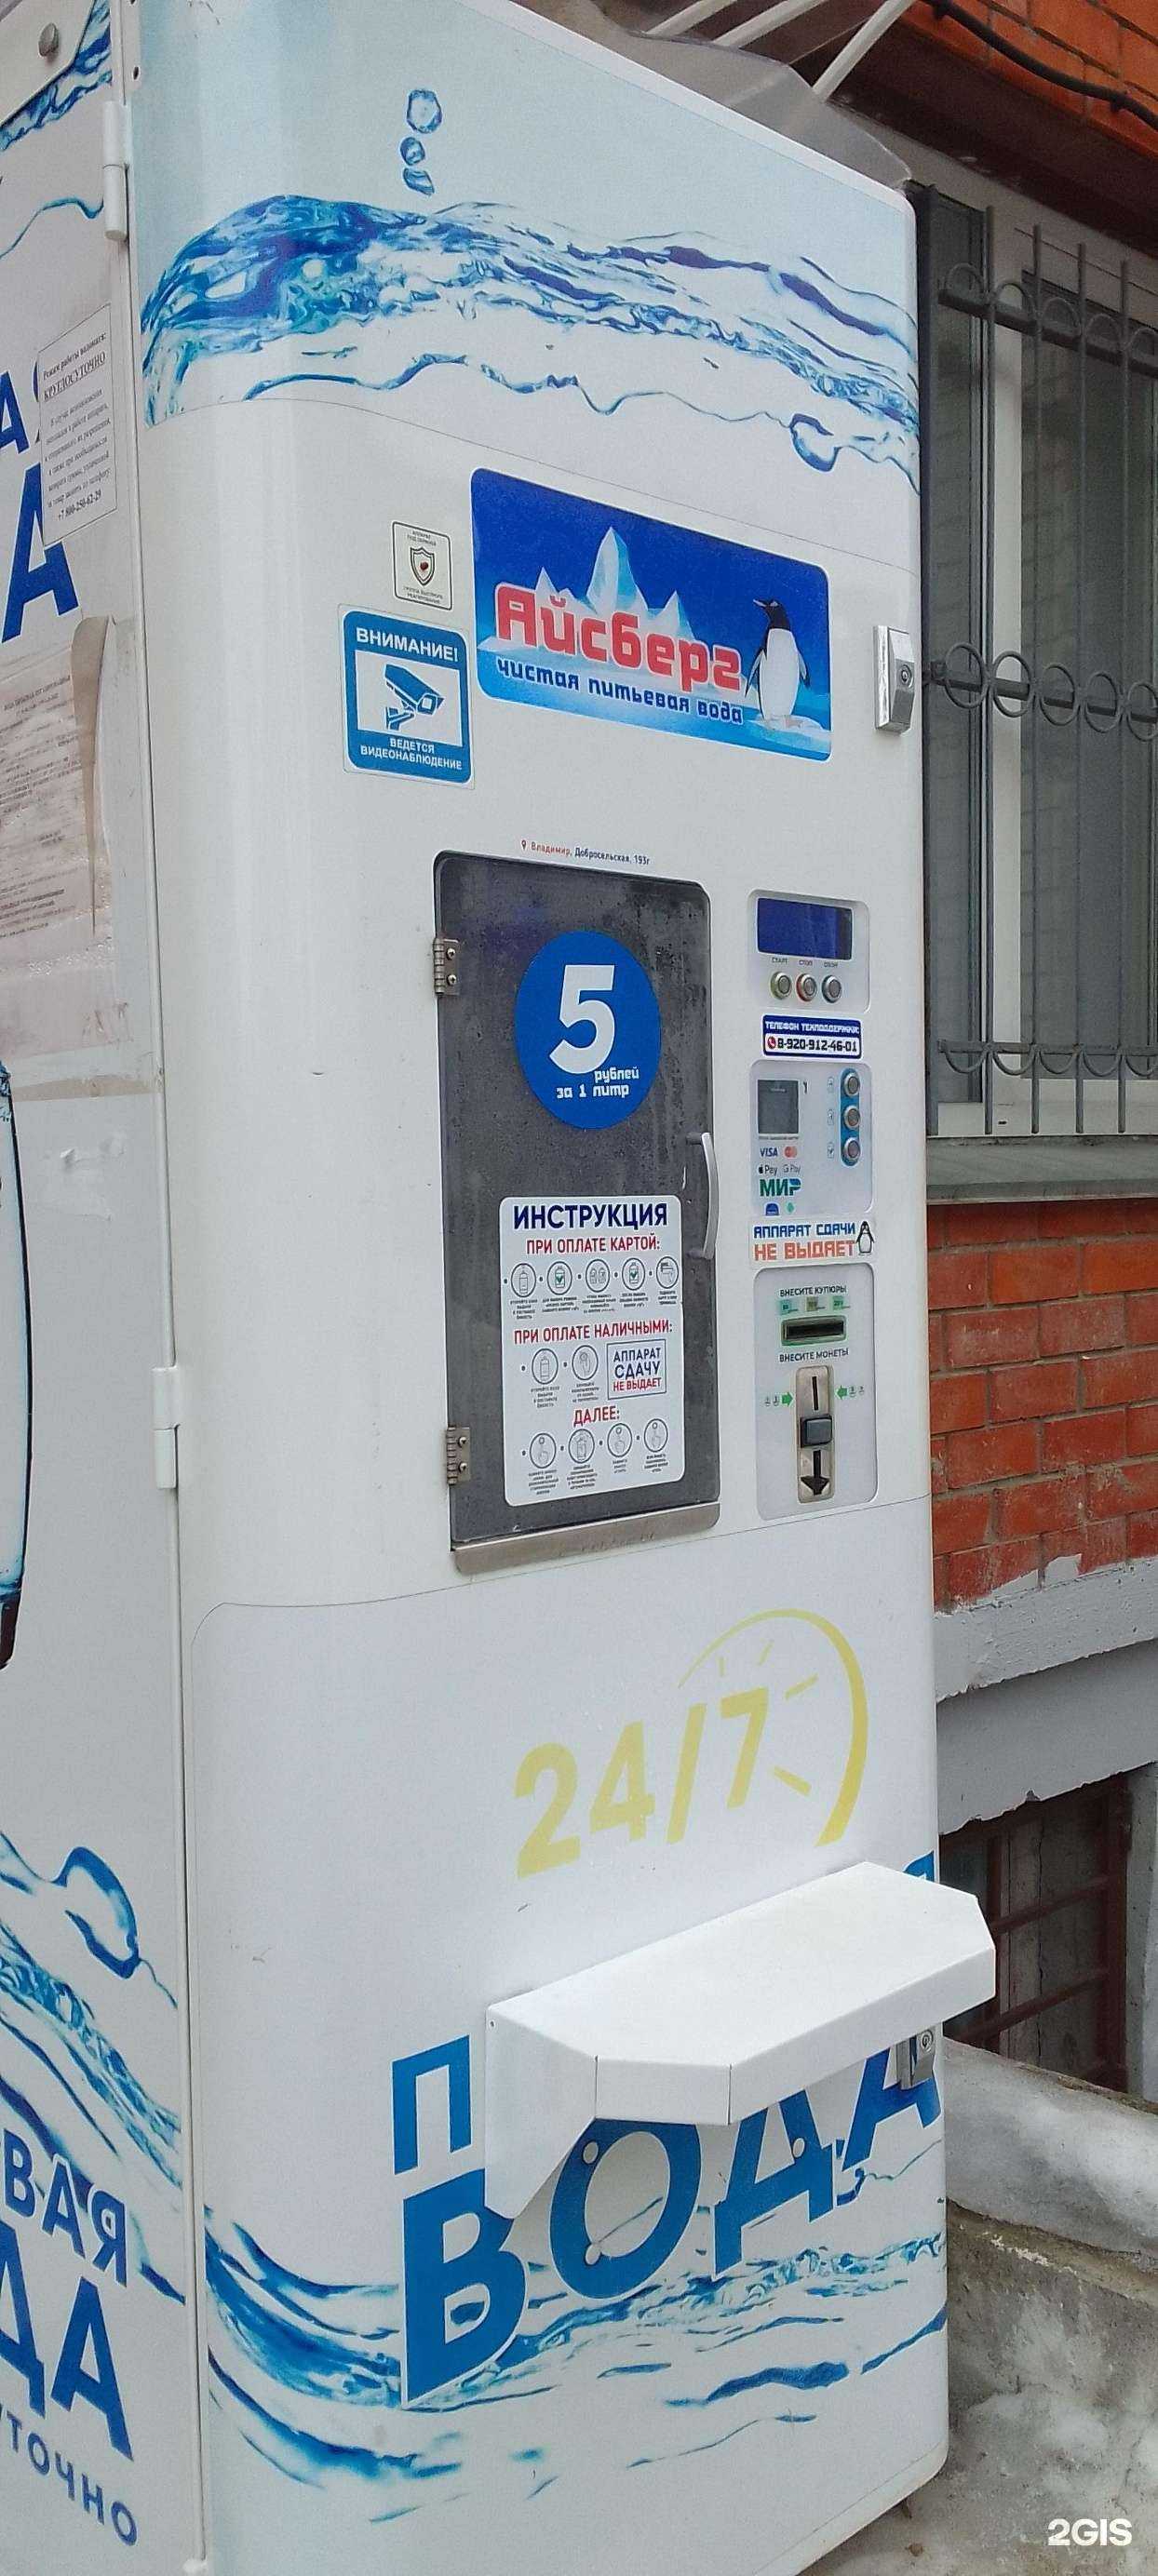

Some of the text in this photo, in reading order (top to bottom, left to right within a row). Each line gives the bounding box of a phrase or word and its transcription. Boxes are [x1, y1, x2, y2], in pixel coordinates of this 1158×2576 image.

[44, 349, 105, 403] КРУГЛОСУТОЧНО
[357, 627, 458, 662] ВНИМАНИЕ!
[495, 584, 742, 692] Айсберг
[497, 658, 743, 724] чистая питьевая вода
[390, 738, 435, 754] ВЕДЕТСЯ
[360, 745, 463, 771] ВИДЕОНАБЛЮДЕНИЕ
[532, 841, 651, 865] Владимир, Добросельская, 193г
[549, 964, 615, 1074] 5
[765, 1020, 800, 1031] ТЕЛЕФОН
[777, 1037, 857, 1053] 8-920-912-46-01
[594, 1067, 640, 1083] рублей
[557, 1083, 629, 1099] за 1 литр
[760, 1147, 778, 1157] VISA
[764, 1164, 778, 1176] Pay
[760, 1178, 801, 1197] МИР
[513, 1202, 667, 1230] ИНСТРУКЦИЯ
[754, 1222, 855, 1239] АППАРАТ СДАЧИ
[527, 1233, 660, 1254] ПРИ ОПЛАТЕ КАРТОЙ:
[754, 1240, 855, 1261] НЕ ВЫДАЕТ
[780, 1284, 847, 1297] ВНЕСИТЕ КУПЮРЫ
[514, 1320, 672, 1345] ПРИ ОПЛАТЕ НАЛИЧНЫМИ:
[613, 1348, 661, 1363] АППАРАТ
[779, 1348, 849, 1362] ВНЕСИТЕ МОНЕТЫ
[614, 1361, 661, 1380] СДАЧУ
[613, 1381, 625, 1392] НЕ
[626, 1377, 662, 1390] ВЫДАЕТ
[572, 1405, 620, 1427] ДАЛЕЕ:
[514, 1685, 769, 1880] 24/7
[403, 2046, 942, 2404] ВОДА
[0, 2404, 138, 2547] ТОЧНО
